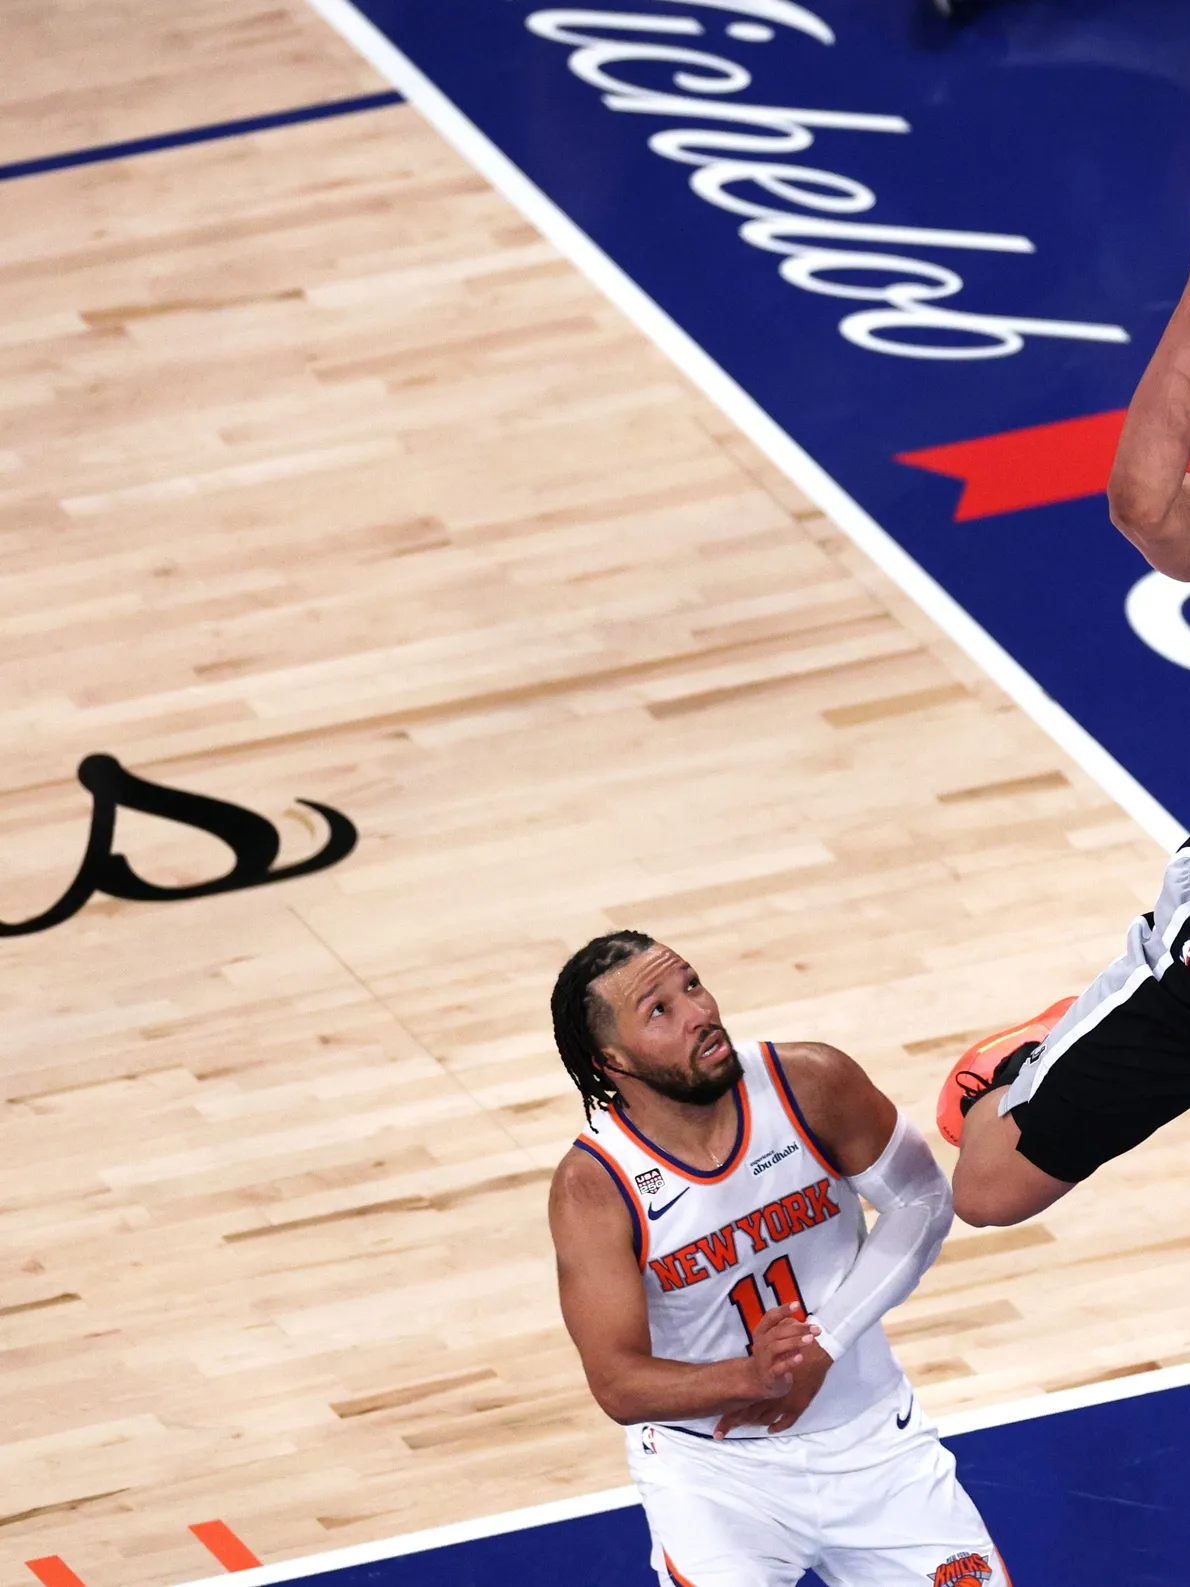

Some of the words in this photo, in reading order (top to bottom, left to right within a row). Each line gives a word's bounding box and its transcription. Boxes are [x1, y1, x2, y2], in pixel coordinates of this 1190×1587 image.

[525, 0, 1131, 360] ichelob
[753, 1160, 773, 1176] abu
[771, 1141, 800, 1164] dhabi
[636, 1170, 660, 1183] USA
[639, 1179, 665, 1195] 250
[649, 1224, 739, 1293] NEW
[736, 1178, 842, 1255] YORK
[728, 1254, 814, 1357] 11
[933, 1553, 993, 1587] KNICKS
